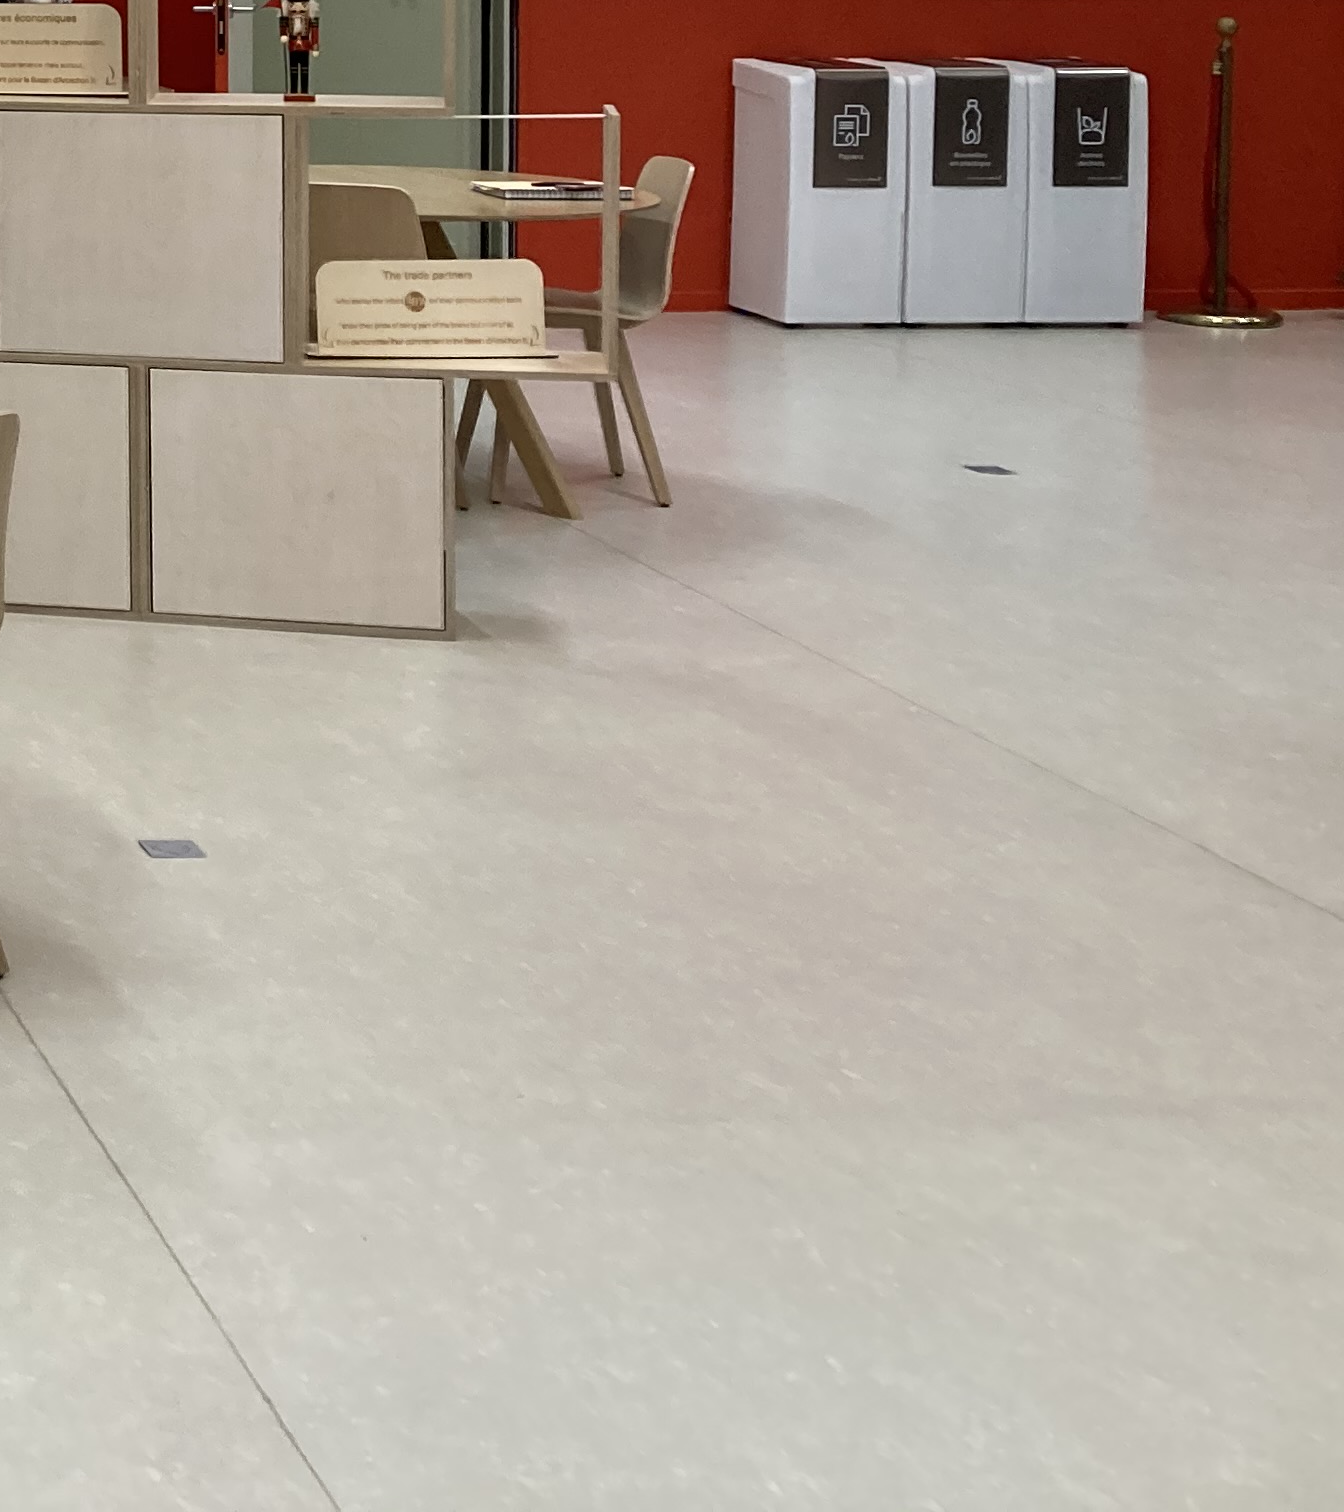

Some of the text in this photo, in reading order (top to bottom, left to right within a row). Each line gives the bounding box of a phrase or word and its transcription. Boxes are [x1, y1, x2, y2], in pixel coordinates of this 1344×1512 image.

[14, 13, 77, 24] économiques
[383, 270, 473, 280] The trade partners
